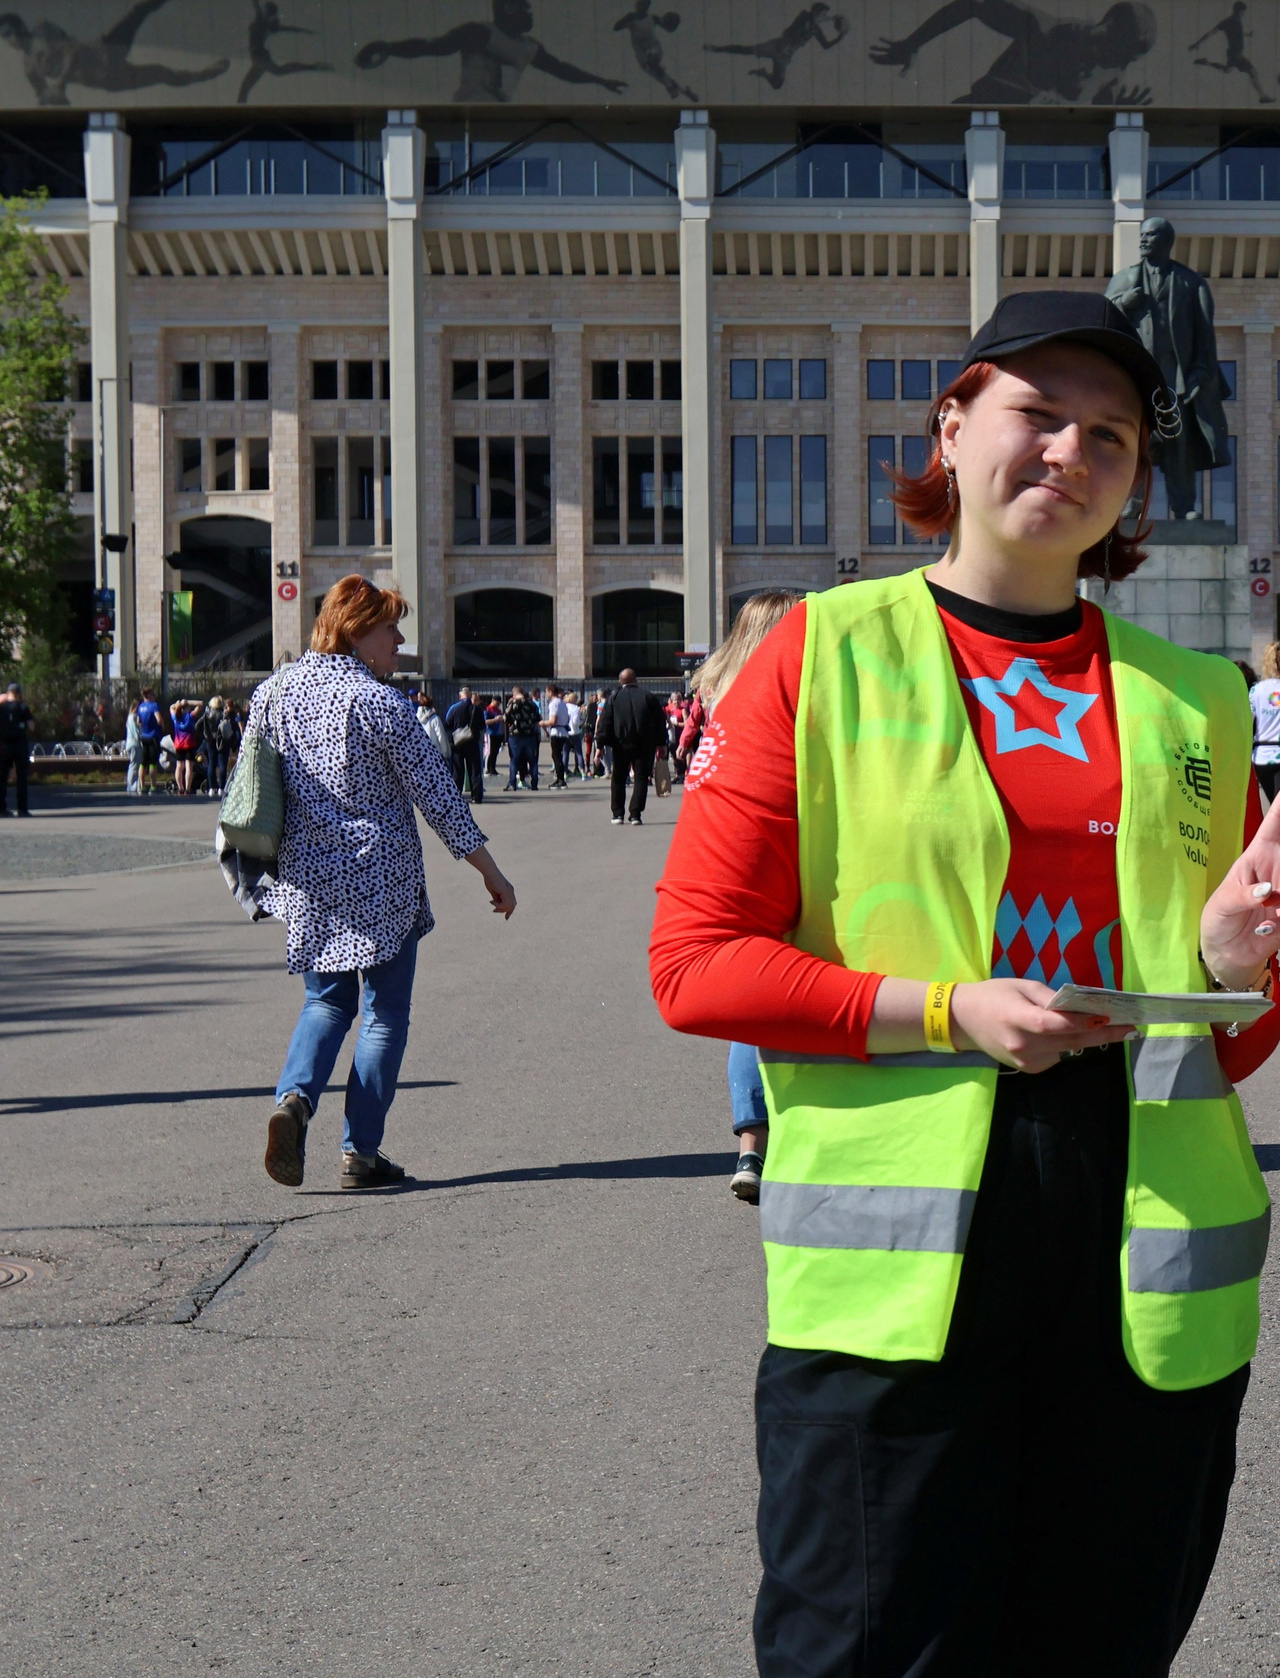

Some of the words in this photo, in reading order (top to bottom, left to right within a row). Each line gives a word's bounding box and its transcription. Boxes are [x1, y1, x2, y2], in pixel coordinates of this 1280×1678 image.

[276, 560, 300, 578] 11
[838, 558, 859, 574] 12
[1250, 558, 1271, 574] 12
[1088, 819, 1118, 836] ВО
